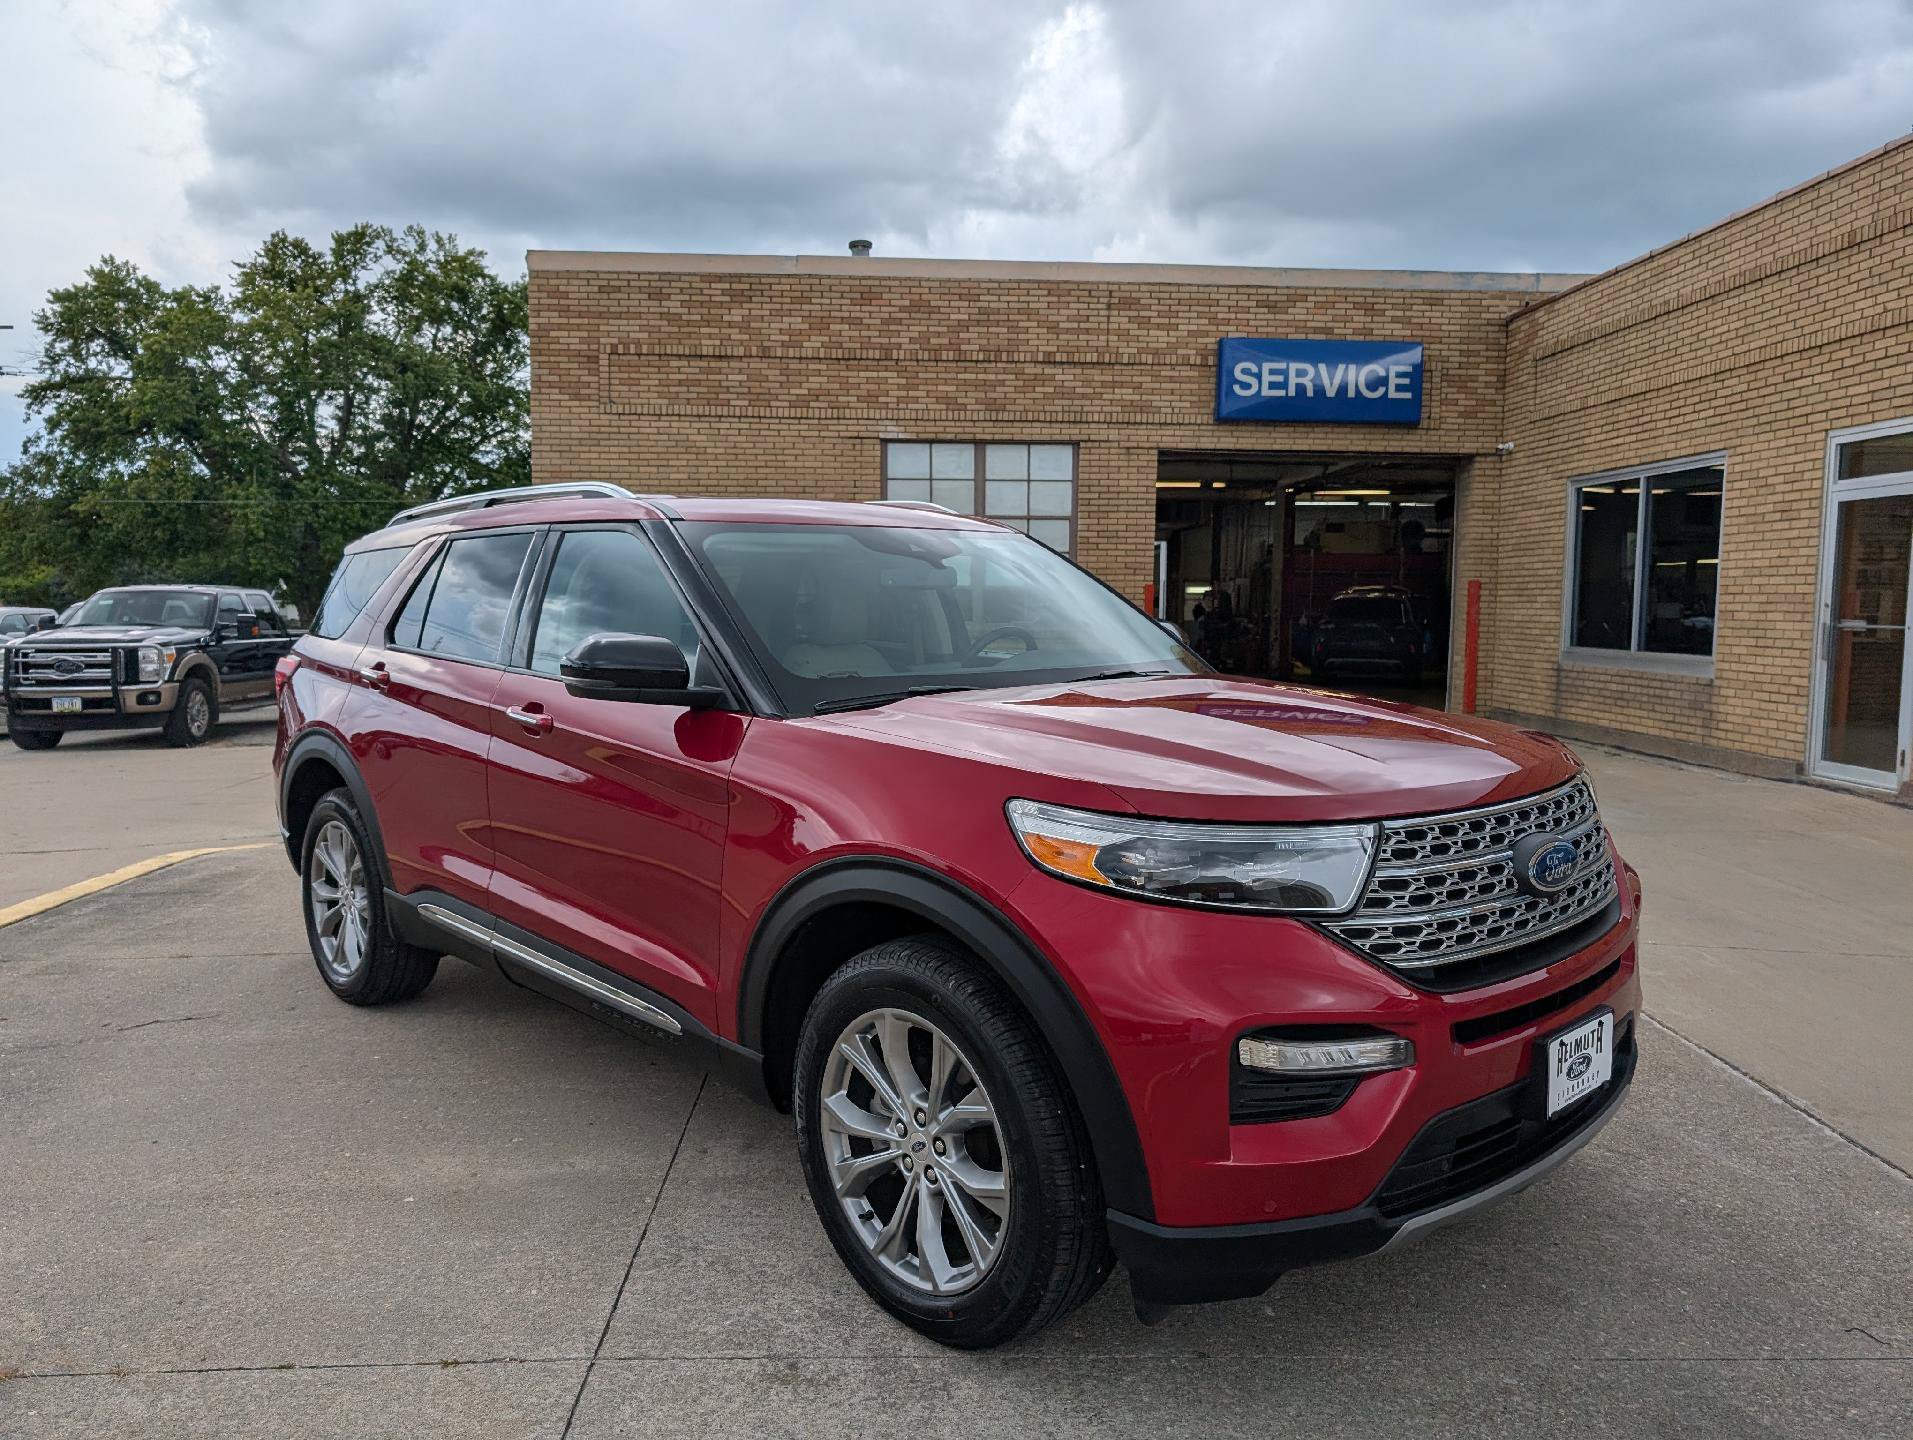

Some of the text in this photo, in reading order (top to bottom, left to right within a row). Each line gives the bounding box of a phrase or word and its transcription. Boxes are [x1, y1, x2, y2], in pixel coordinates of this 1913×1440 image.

[1232, 361, 1413, 399] SERVICE
[1545, 852, 1573, 881] Ford
[1557, 1022, 1604, 1078] HELMUTH
